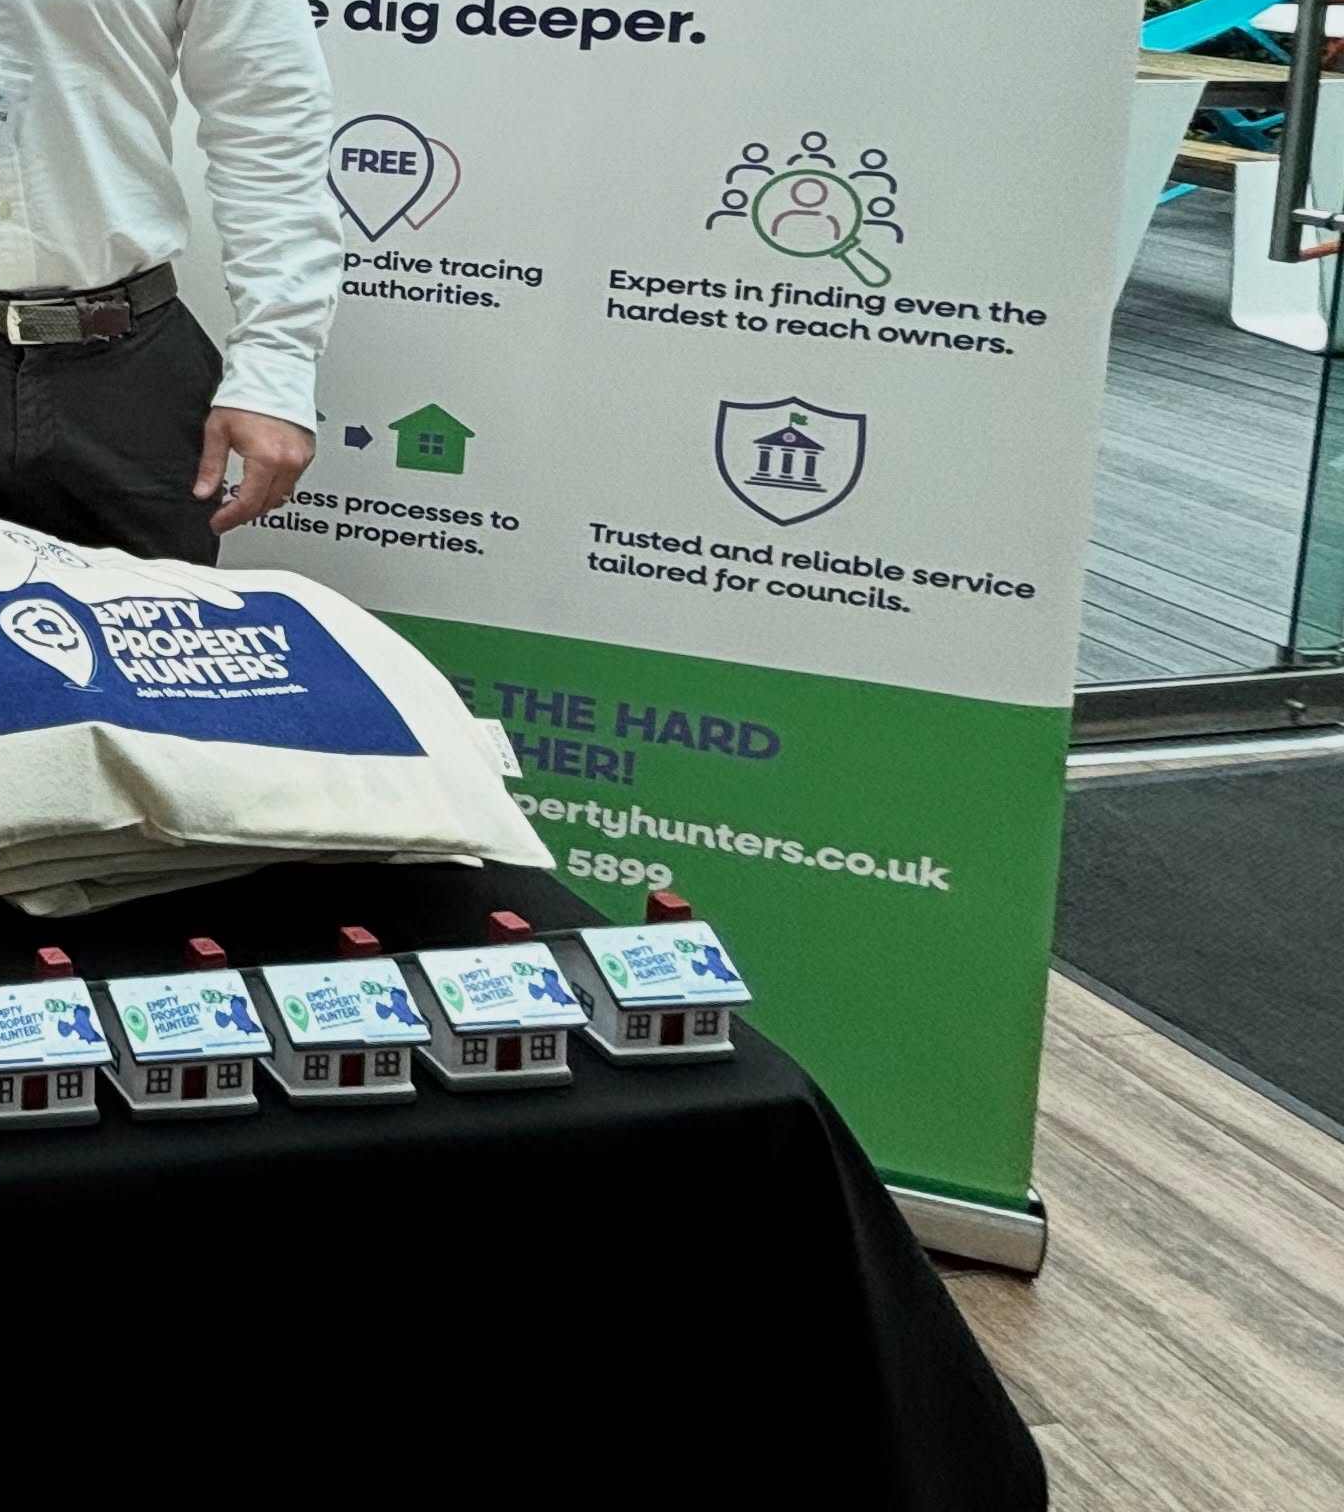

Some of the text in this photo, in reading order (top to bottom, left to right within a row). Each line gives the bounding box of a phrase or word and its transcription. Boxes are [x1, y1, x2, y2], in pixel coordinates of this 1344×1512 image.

[341, 148, 417, 175] FREE
[440, 258, 542, 287] tracing
[342, 280, 500, 307] authorities.
[610, 270, 1047, 325] Experts in finding even the
[607, 298, 1013, 354] hardest to reach owners.
[345, 497, 519, 530] processes to
[336, 523, 483, 554] properties.
[590, 523, 1035, 599] Trusted and reliable service
[587, 552, 910, 612] tailored for councils.
[90, 599, 204, 629] EMPTY
[102, 625, 291, 658] PROPERTY
[491, 682, 596, 733] THE
[615, 702, 780, 759] HARD
[568, 849, 673, 890] 5899
